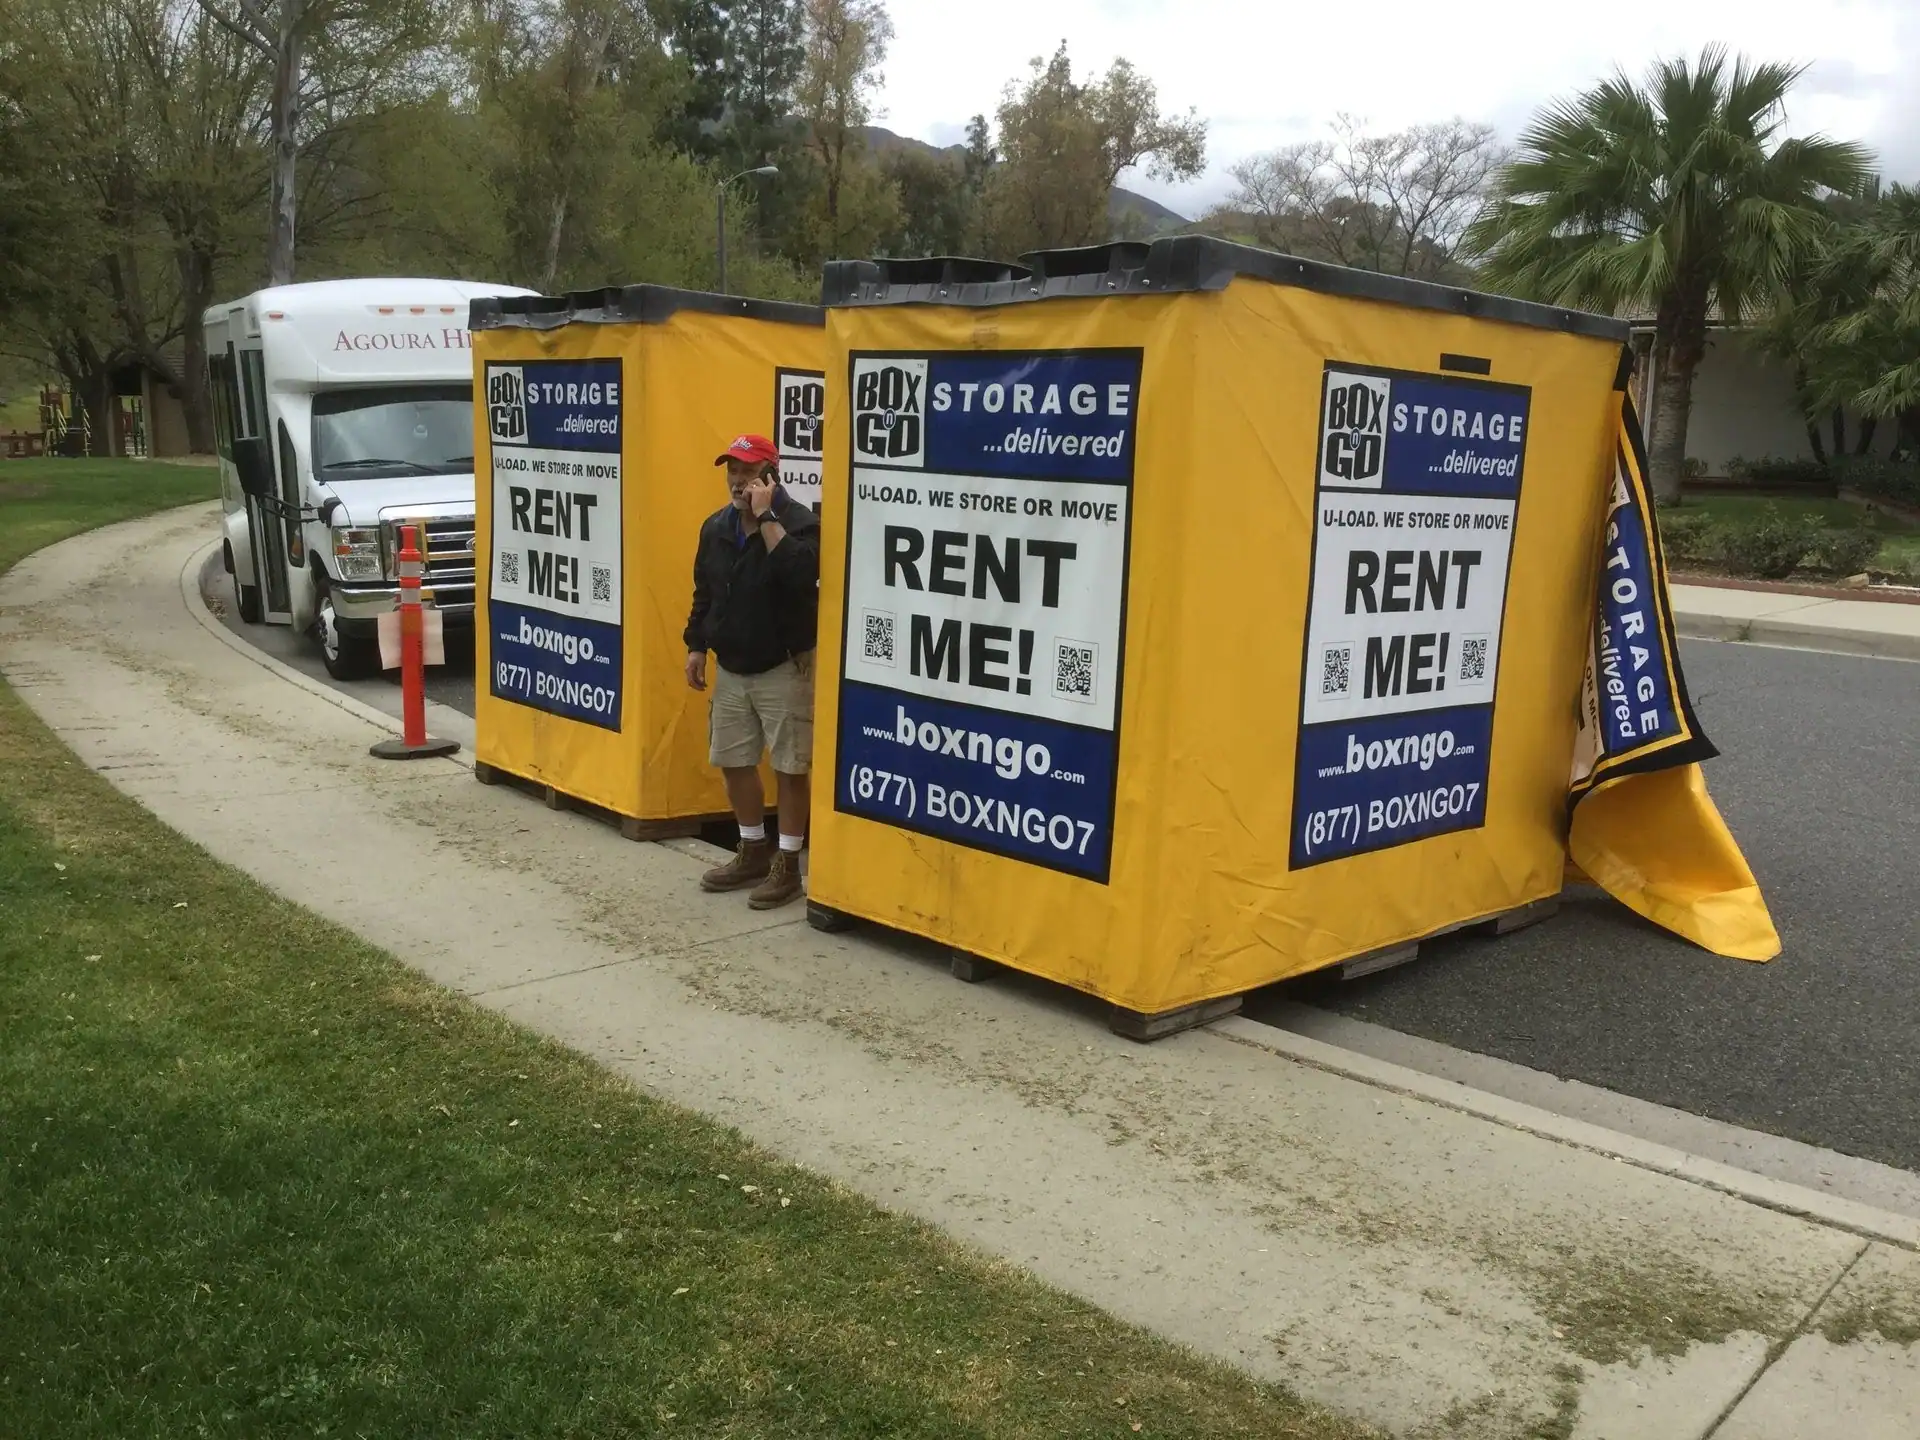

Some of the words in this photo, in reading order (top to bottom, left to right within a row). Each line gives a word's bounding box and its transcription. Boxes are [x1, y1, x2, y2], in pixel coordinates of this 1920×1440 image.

[333, 330, 436, 351] AGOURA
[490, 371, 523, 406] BOX
[527, 382, 619, 405] STORAGE
[857, 366, 922, 414] BOX
[932, 382, 1131, 416] STORAGE
[1327, 382, 1386, 434] BOX
[490, 405, 525, 438] GO
[556, 413, 618, 435] ...delivered
[857, 413, 920, 459] GO
[983, 427, 1124, 457] ...delivered
[1392, 402, 1523, 443] STORAGE
[495, 457, 529, 472] U-LOAD.
[532, 460, 546, 473] WE
[548, 461, 571, 475] STORE
[572, 464, 584, 477] OR
[586, 465, 618, 479] MOVE
[784, 472, 823, 486] U-LO
[1325, 430, 1382, 481] GO
[1428, 450, 1518, 477] ...delivered
[509, 486, 597, 542] RENT
[858, 484, 922, 506] U-LOAD.
[928, 490, 954, 509] WE
[959, 492, 1017, 514] STORE
[1023, 498, 1053, 517] OR
[1061, 501, 1117, 522] MOVE
[1323, 509, 1379, 528] U-LOAD.
[1383, 511, 1404, 528] WE
[1407, 511, 1450, 529] STORE
[1453, 513, 1470, 530] OR
[1473, 514, 1509, 530] MOVE
[527, 549, 580, 604] ME!
[884, 524, 1077, 609] RENT
[1344, 550, 1482, 615] RENT
[500, 615, 610, 665] www.boxngo.com
[1606, 521, 1660, 735] STORAGE
[909, 613, 1035, 696] ME!
[1363, 632, 1451, 700] ME!
[496, 660, 531, 698] (877)
[536, 670, 616, 715] BOXNGO7
[862, 704, 1085, 785] www.boxngo.com
[1318, 730, 1475, 778] www.boxngo.com
[849, 763, 917, 818] (877)
[926, 782, 1095, 856] BOXNGO7
[1304, 803, 1361, 855] (877)
[1367, 782, 1480, 835] BOXNGO7
